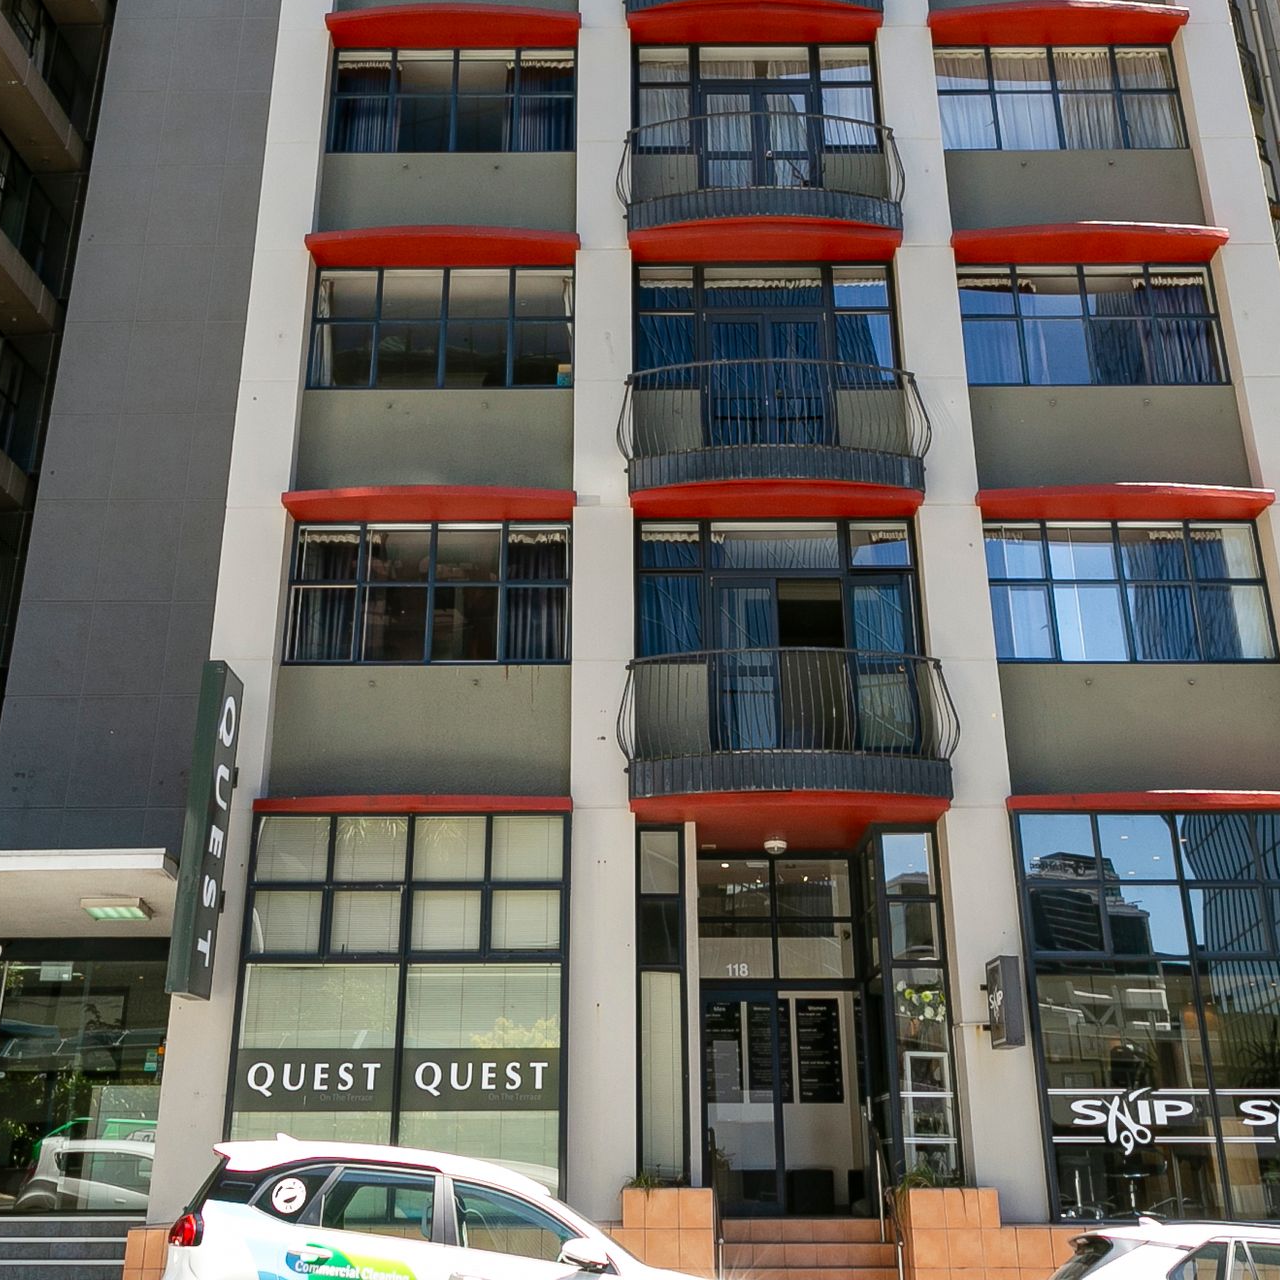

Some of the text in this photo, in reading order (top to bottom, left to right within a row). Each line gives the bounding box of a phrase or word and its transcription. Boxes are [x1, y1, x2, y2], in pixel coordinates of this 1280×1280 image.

[197, 696, 236, 968] QUEST
[726, 963, 748, 977] 118
[247, 1062, 381, 1097] QUEST
[414, 1062, 549, 1097] QUEST
[515, 1093, 542, 1102] Terrace
[295, 1260, 360, 1279] Commercial
